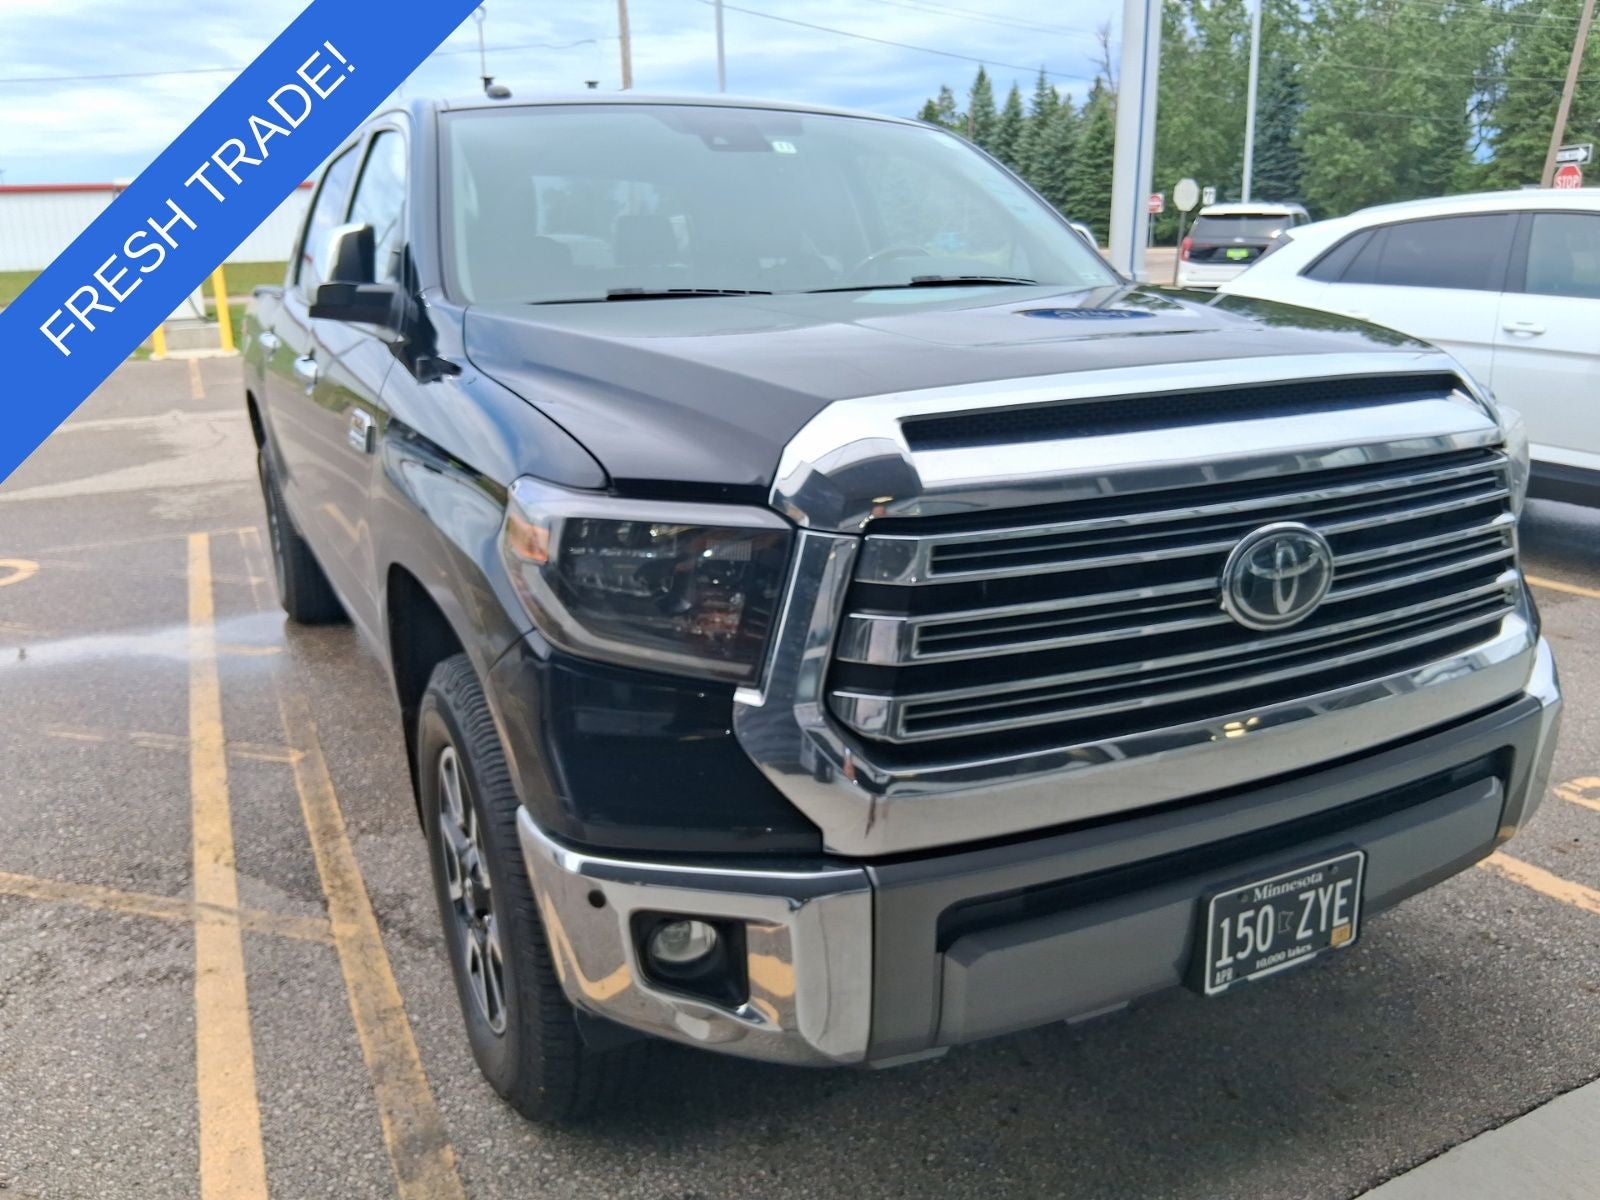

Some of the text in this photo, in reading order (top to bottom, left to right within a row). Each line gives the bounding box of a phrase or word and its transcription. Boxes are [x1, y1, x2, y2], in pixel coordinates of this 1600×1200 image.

[1555, 175, 1582, 189] STOP
[1253, 872, 1323, 903] Minnesota
[1215, 878, 1353, 968] 150 ZYE
[1256, 944, 1312, 970] 10,000 lakes
[1215, 967, 1233, 986] APR
